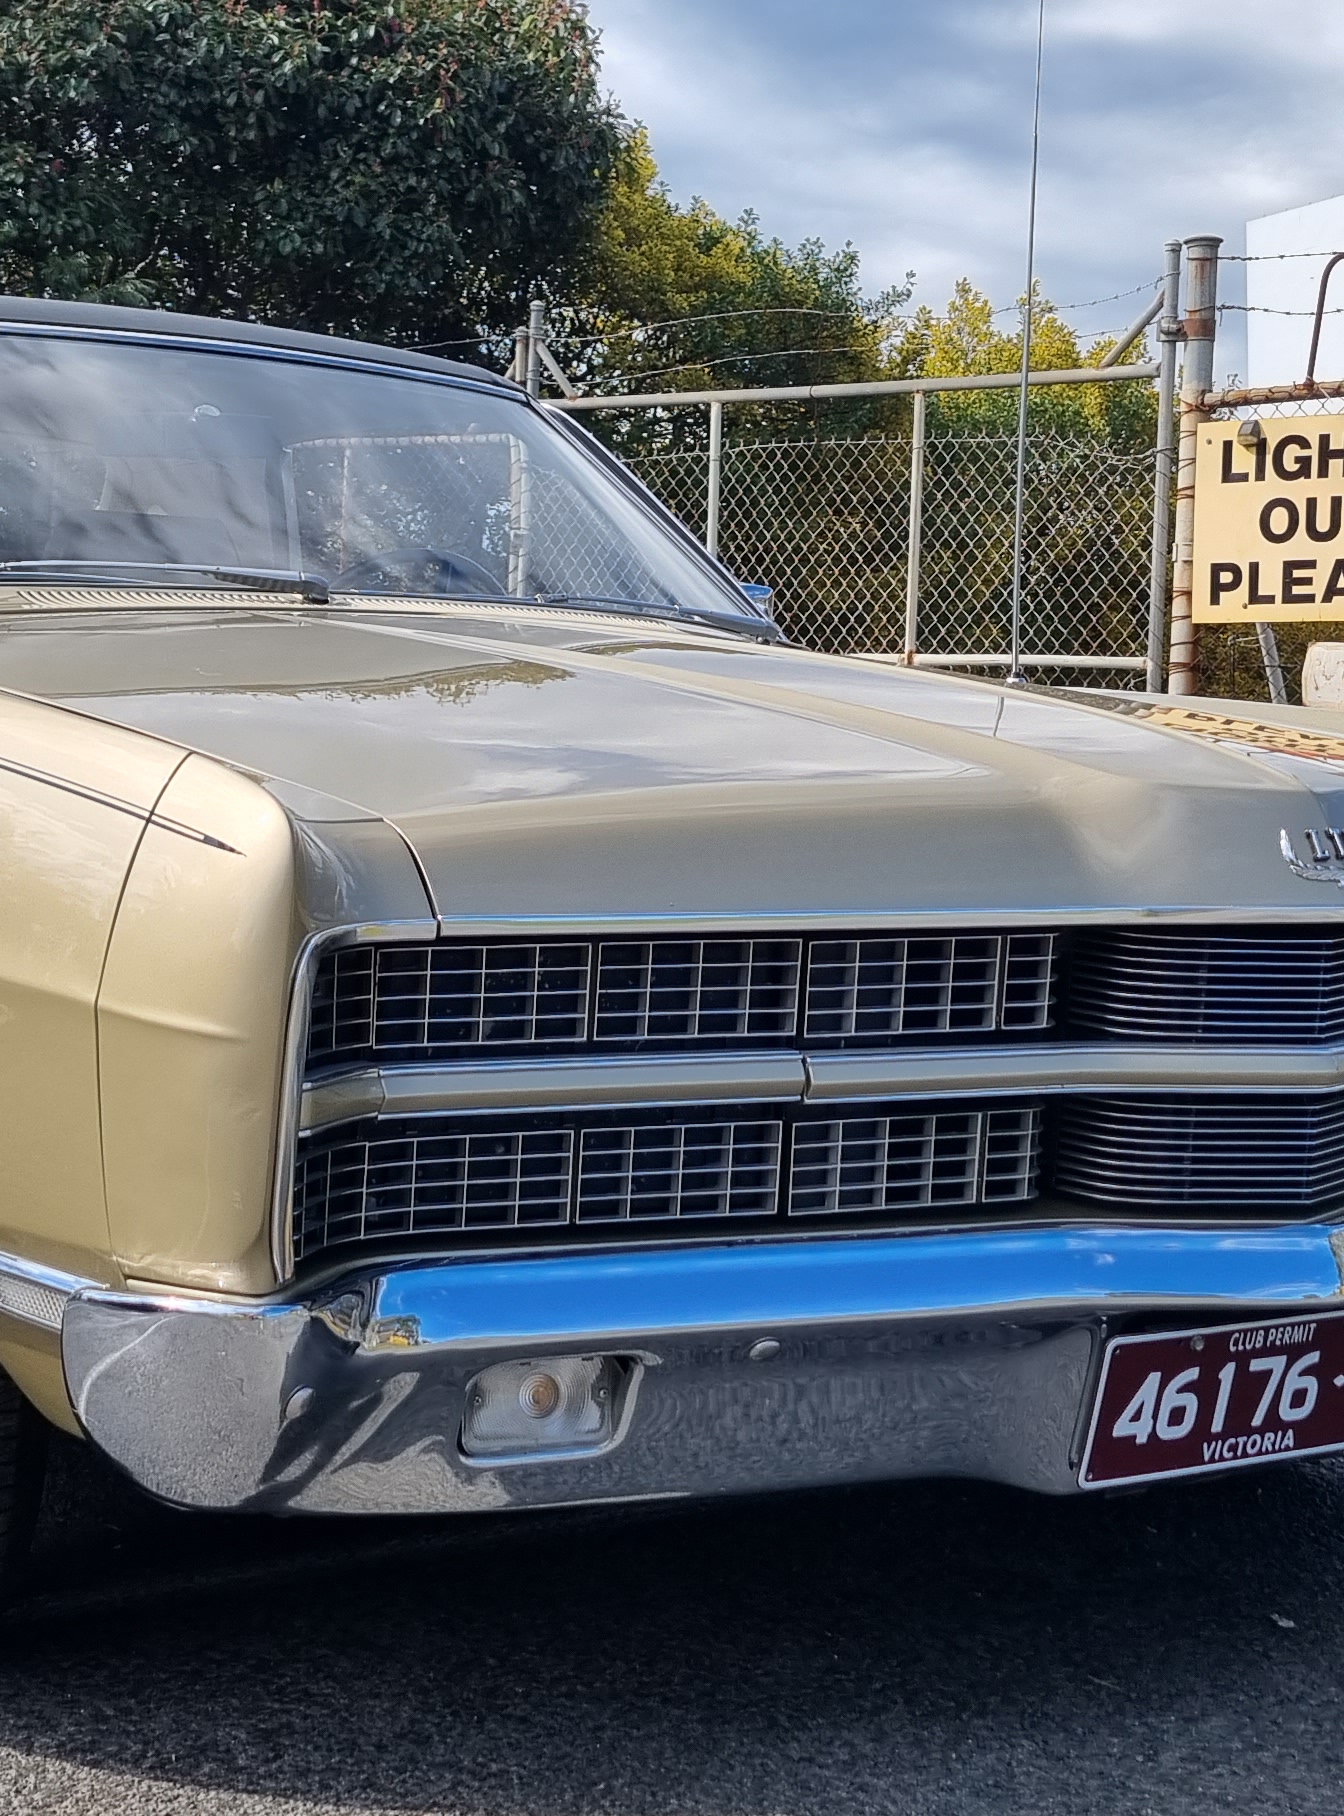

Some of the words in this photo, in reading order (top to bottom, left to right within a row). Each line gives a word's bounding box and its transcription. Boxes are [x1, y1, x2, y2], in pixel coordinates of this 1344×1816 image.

[1229, 1329, 1264, 1353] CLUB
[1266, 1323, 1317, 1348] PERMIT
[1202, 1429, 1295, 1463] VICTORIA
